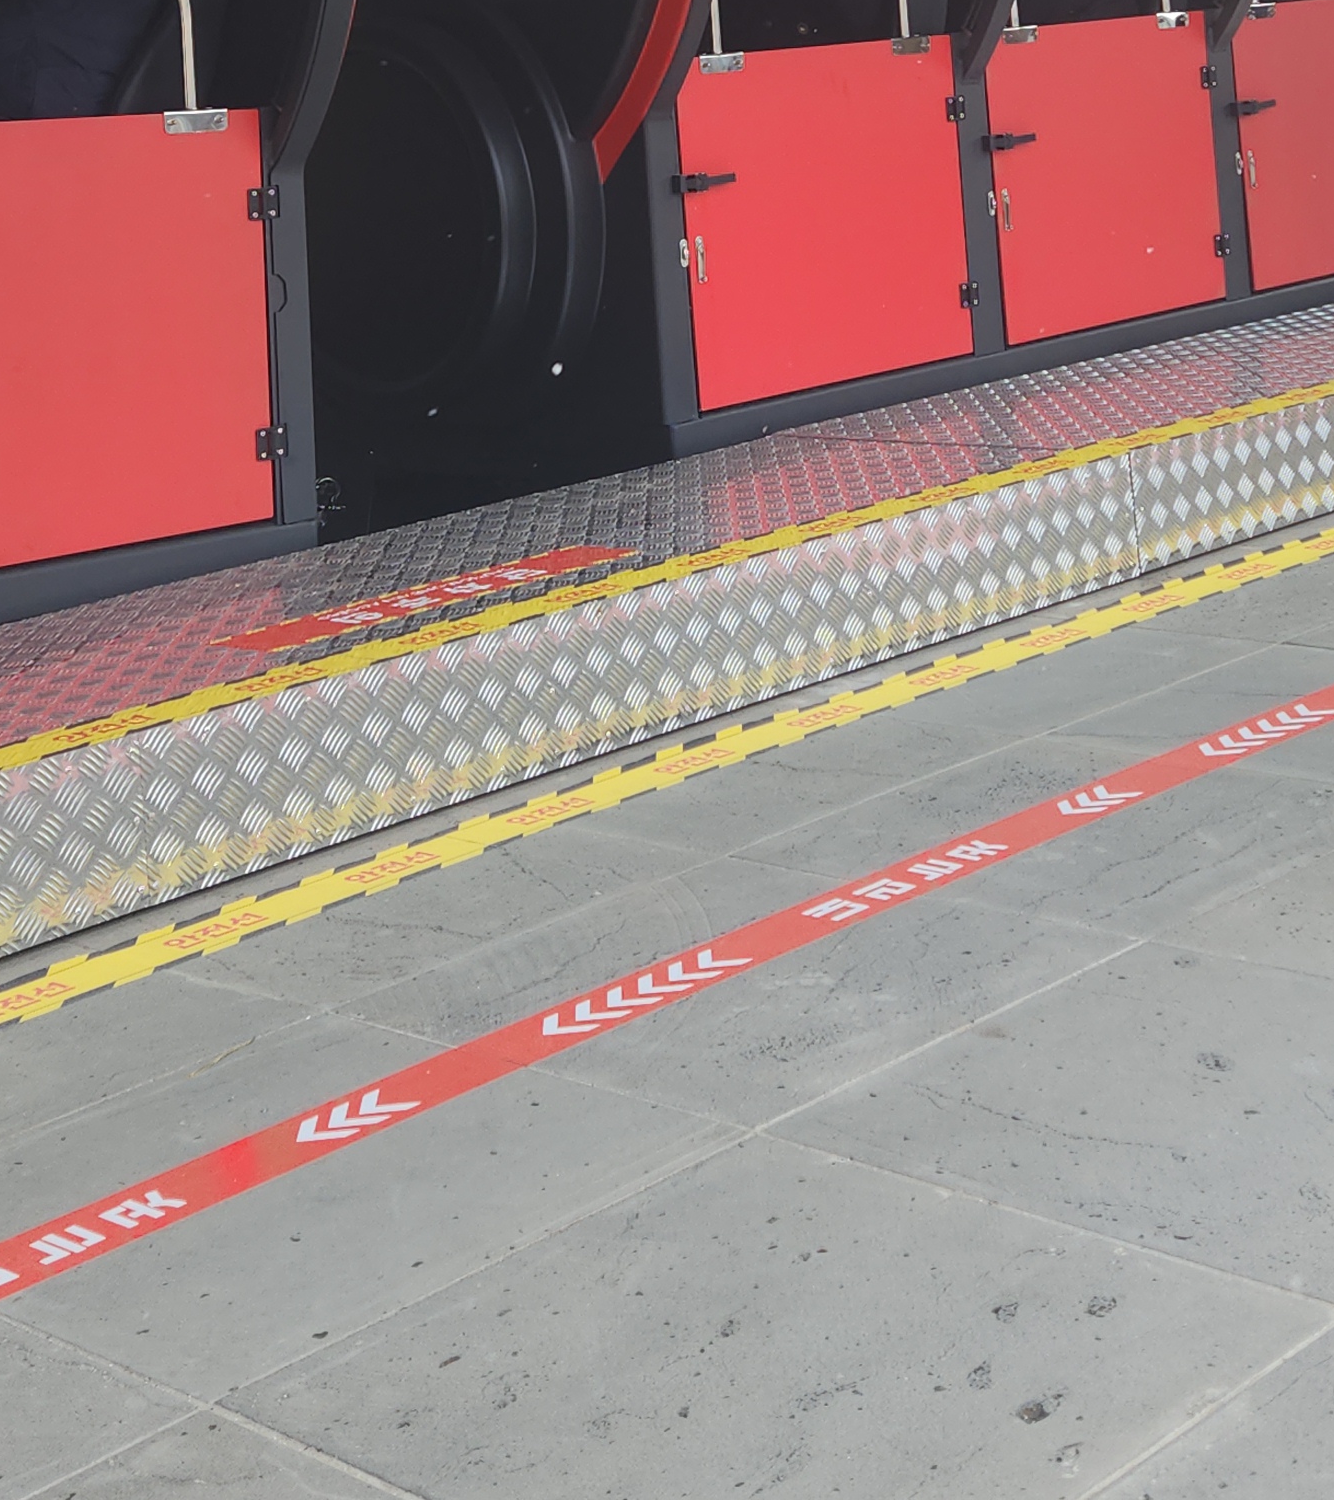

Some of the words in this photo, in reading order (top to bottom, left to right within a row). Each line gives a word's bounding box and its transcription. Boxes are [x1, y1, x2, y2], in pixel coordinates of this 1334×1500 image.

[652, 747, 736, 775] 안전선
[505, 796, 596, 826] 안전선
[343, 850, 442, 885] 안전선
[163, 911, 269, 951] 안전선
